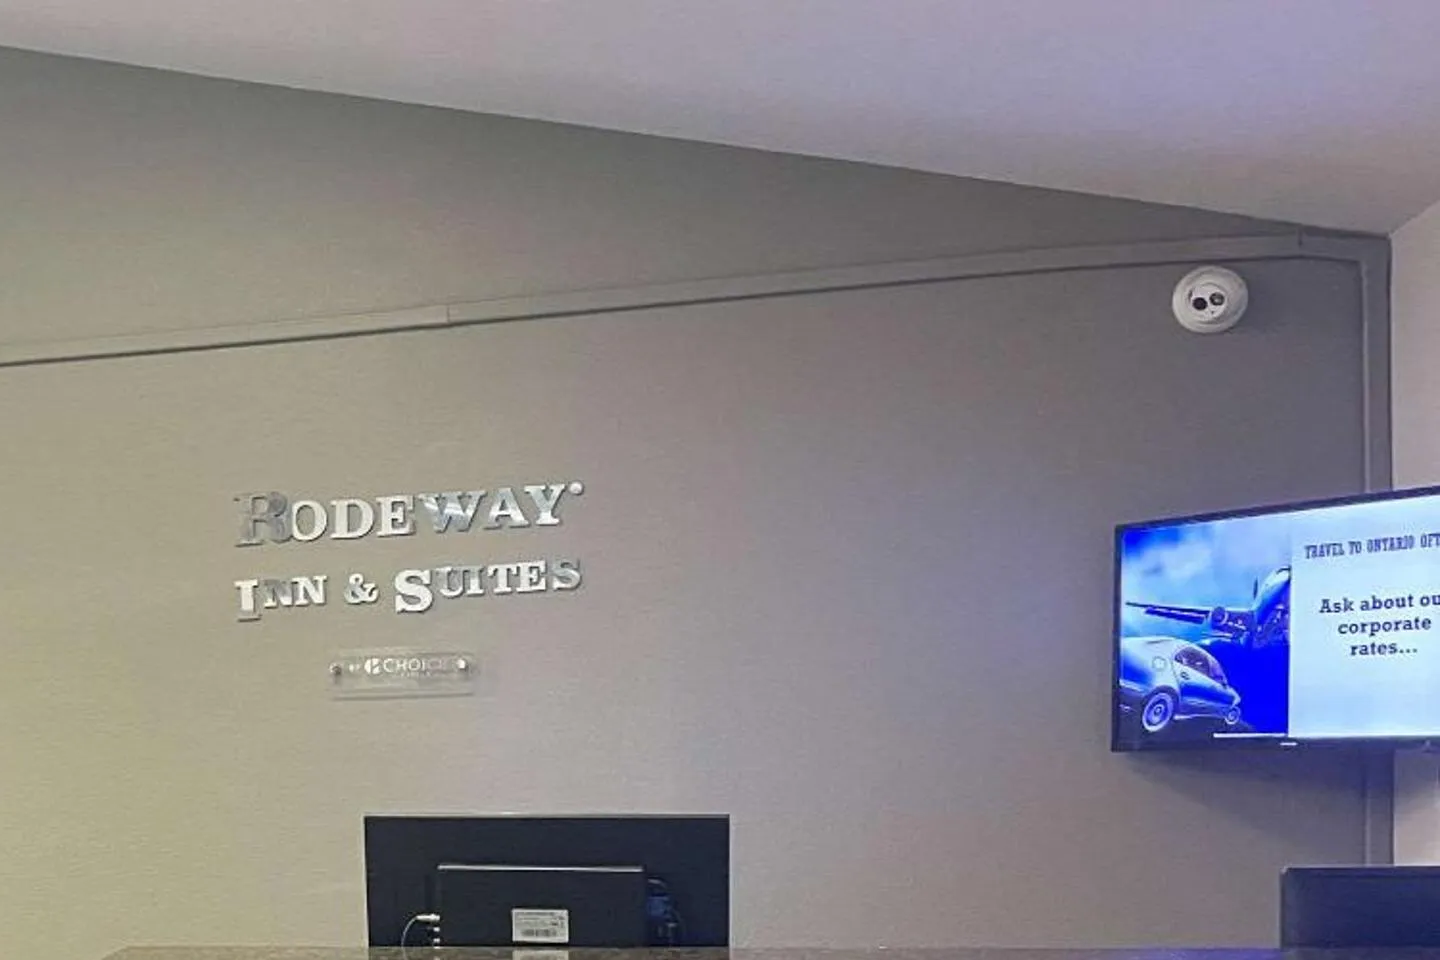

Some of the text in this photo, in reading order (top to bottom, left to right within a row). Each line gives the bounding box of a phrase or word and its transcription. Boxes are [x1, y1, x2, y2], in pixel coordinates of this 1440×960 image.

[234, 484, 564, 547] RODEWAY
[1304, 543, 1345, 559] TRAVEL
[1348, 541, 1362, 555] TO
[1367, 535, 1415, 553] ONTARIO
[235, 558, 582, 621] INN & SUITES
[1319, 598, 1354, 613] Ask
[1360, 595, 1414, 611] about
[1338, 617, 1432, 637] corporate
[1350, 642, 1418, 656] rates...
